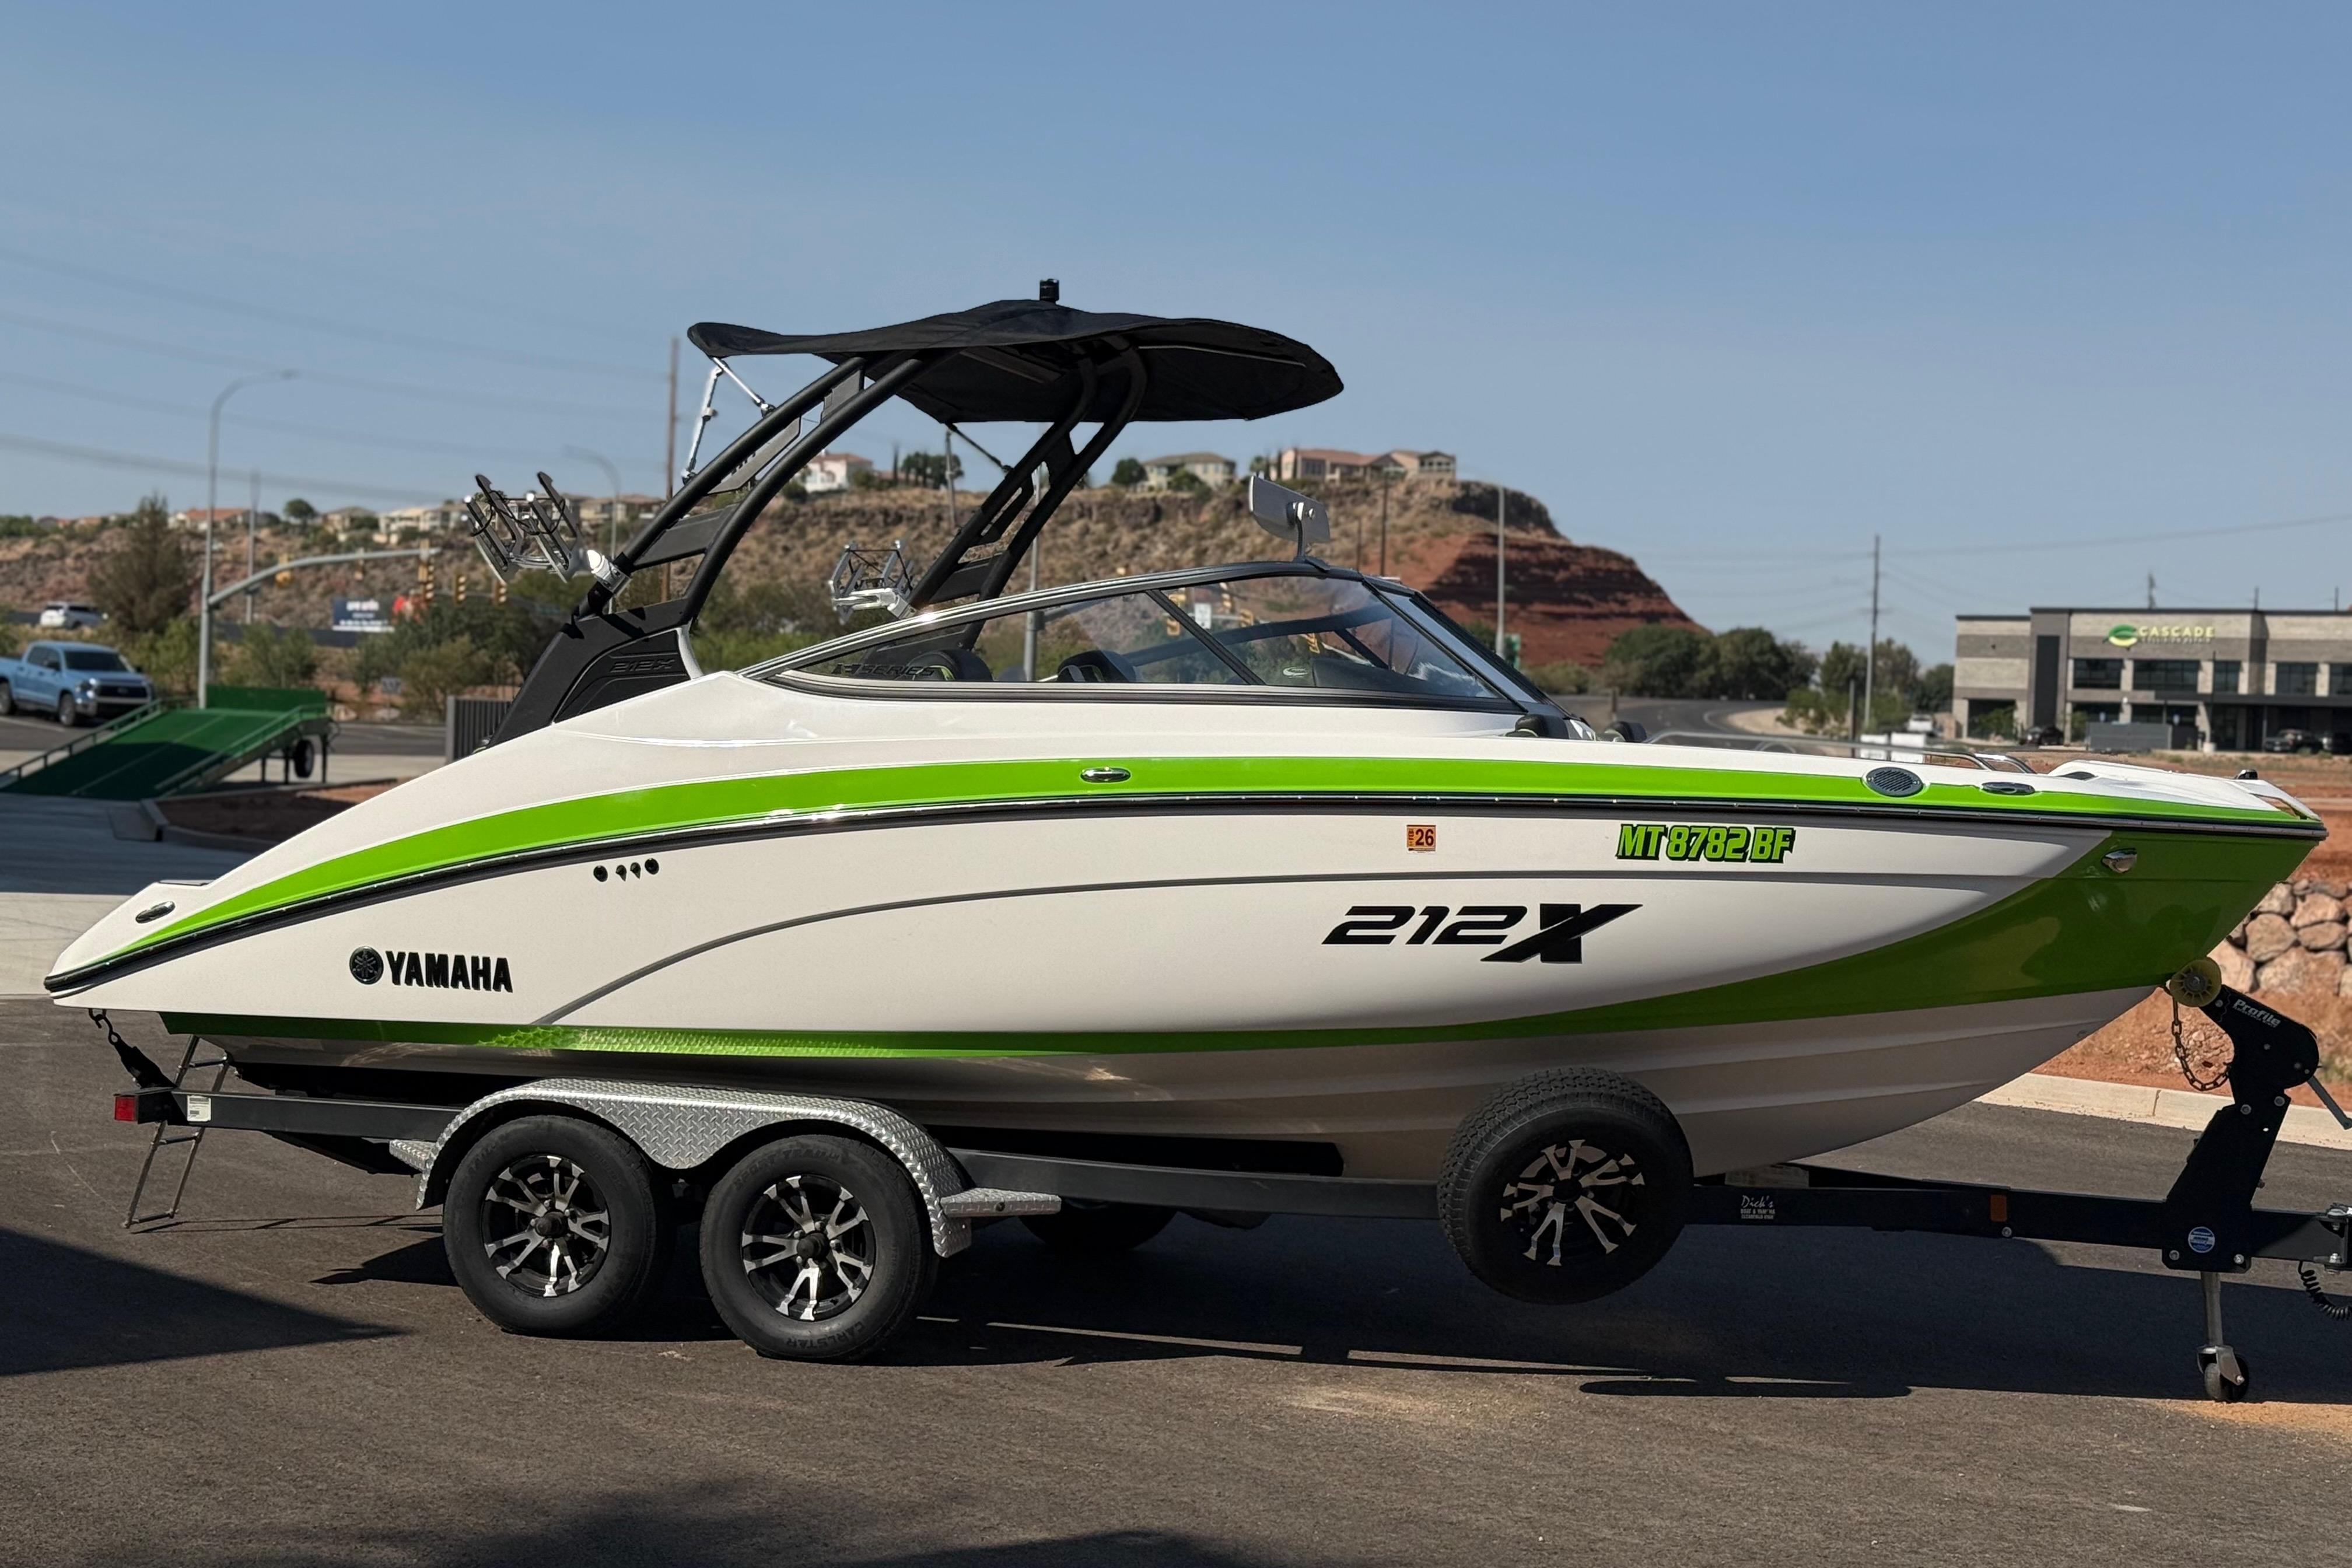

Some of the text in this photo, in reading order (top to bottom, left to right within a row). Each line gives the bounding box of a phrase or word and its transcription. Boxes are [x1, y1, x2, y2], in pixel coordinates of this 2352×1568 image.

[2138, 626, 2215, 637] CASCADE
[610, 659, 675, 673] 212X
[859, 664, 935, 676] SERIES
[1415, 828, 1434, 846] 26
[1616, 824, 1796, 863] MT 8782 BF
[1321, 904, 1643, 964] 212X
[385, 950, 513, 993] YAMAHA
[2232, 999, 2281, 1026] Profile
[1741, 1195, 1773, 1208] Dick's
[787, 1321, 866, 1349] CARLSTAR
